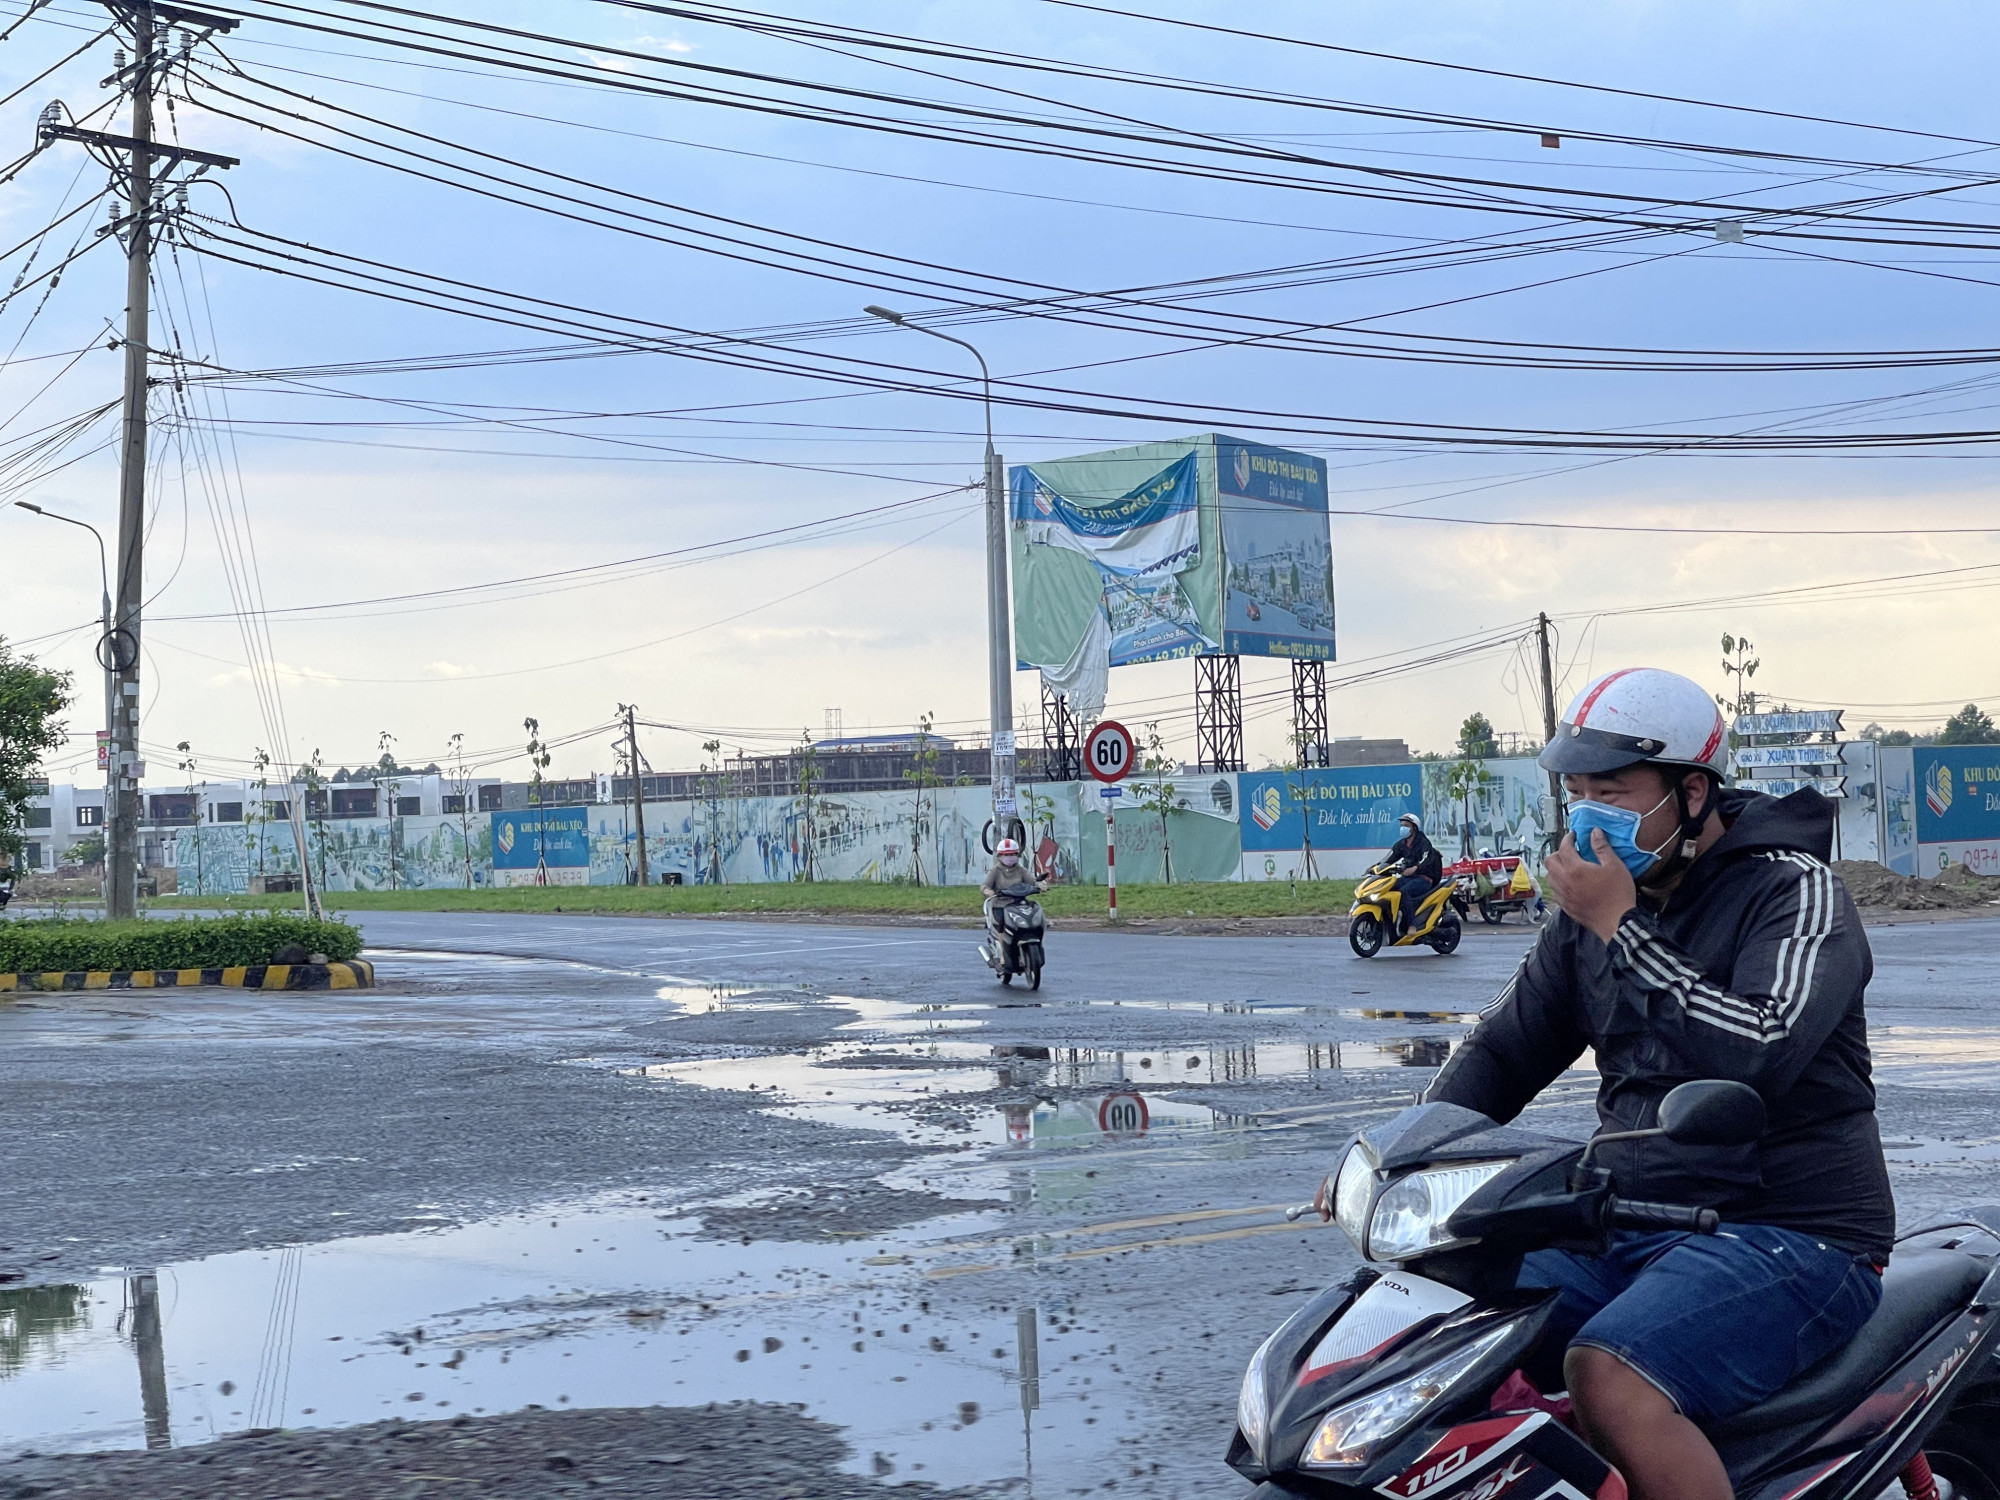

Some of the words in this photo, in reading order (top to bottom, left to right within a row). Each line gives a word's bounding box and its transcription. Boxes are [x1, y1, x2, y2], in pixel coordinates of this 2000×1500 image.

[1252, 456, 1266, 473] KHU
[1172, 646, 1186, 659] 79
[1189, 642, 1203, 657] 69
[1097, 739, 1122, 766] 60
[1964, 767, 1985, 782] KHU
[1320, 784, 1338, 800] ĐÔ
[1339, 785, 1359, 801] THỊ
[1361, 782, 1384, 798] BÀU
[1340, 808, 1353, 828] lộc
[1355, 807, 1375, 825] sinh
[1405, 1445, 1468, 1495] 110
